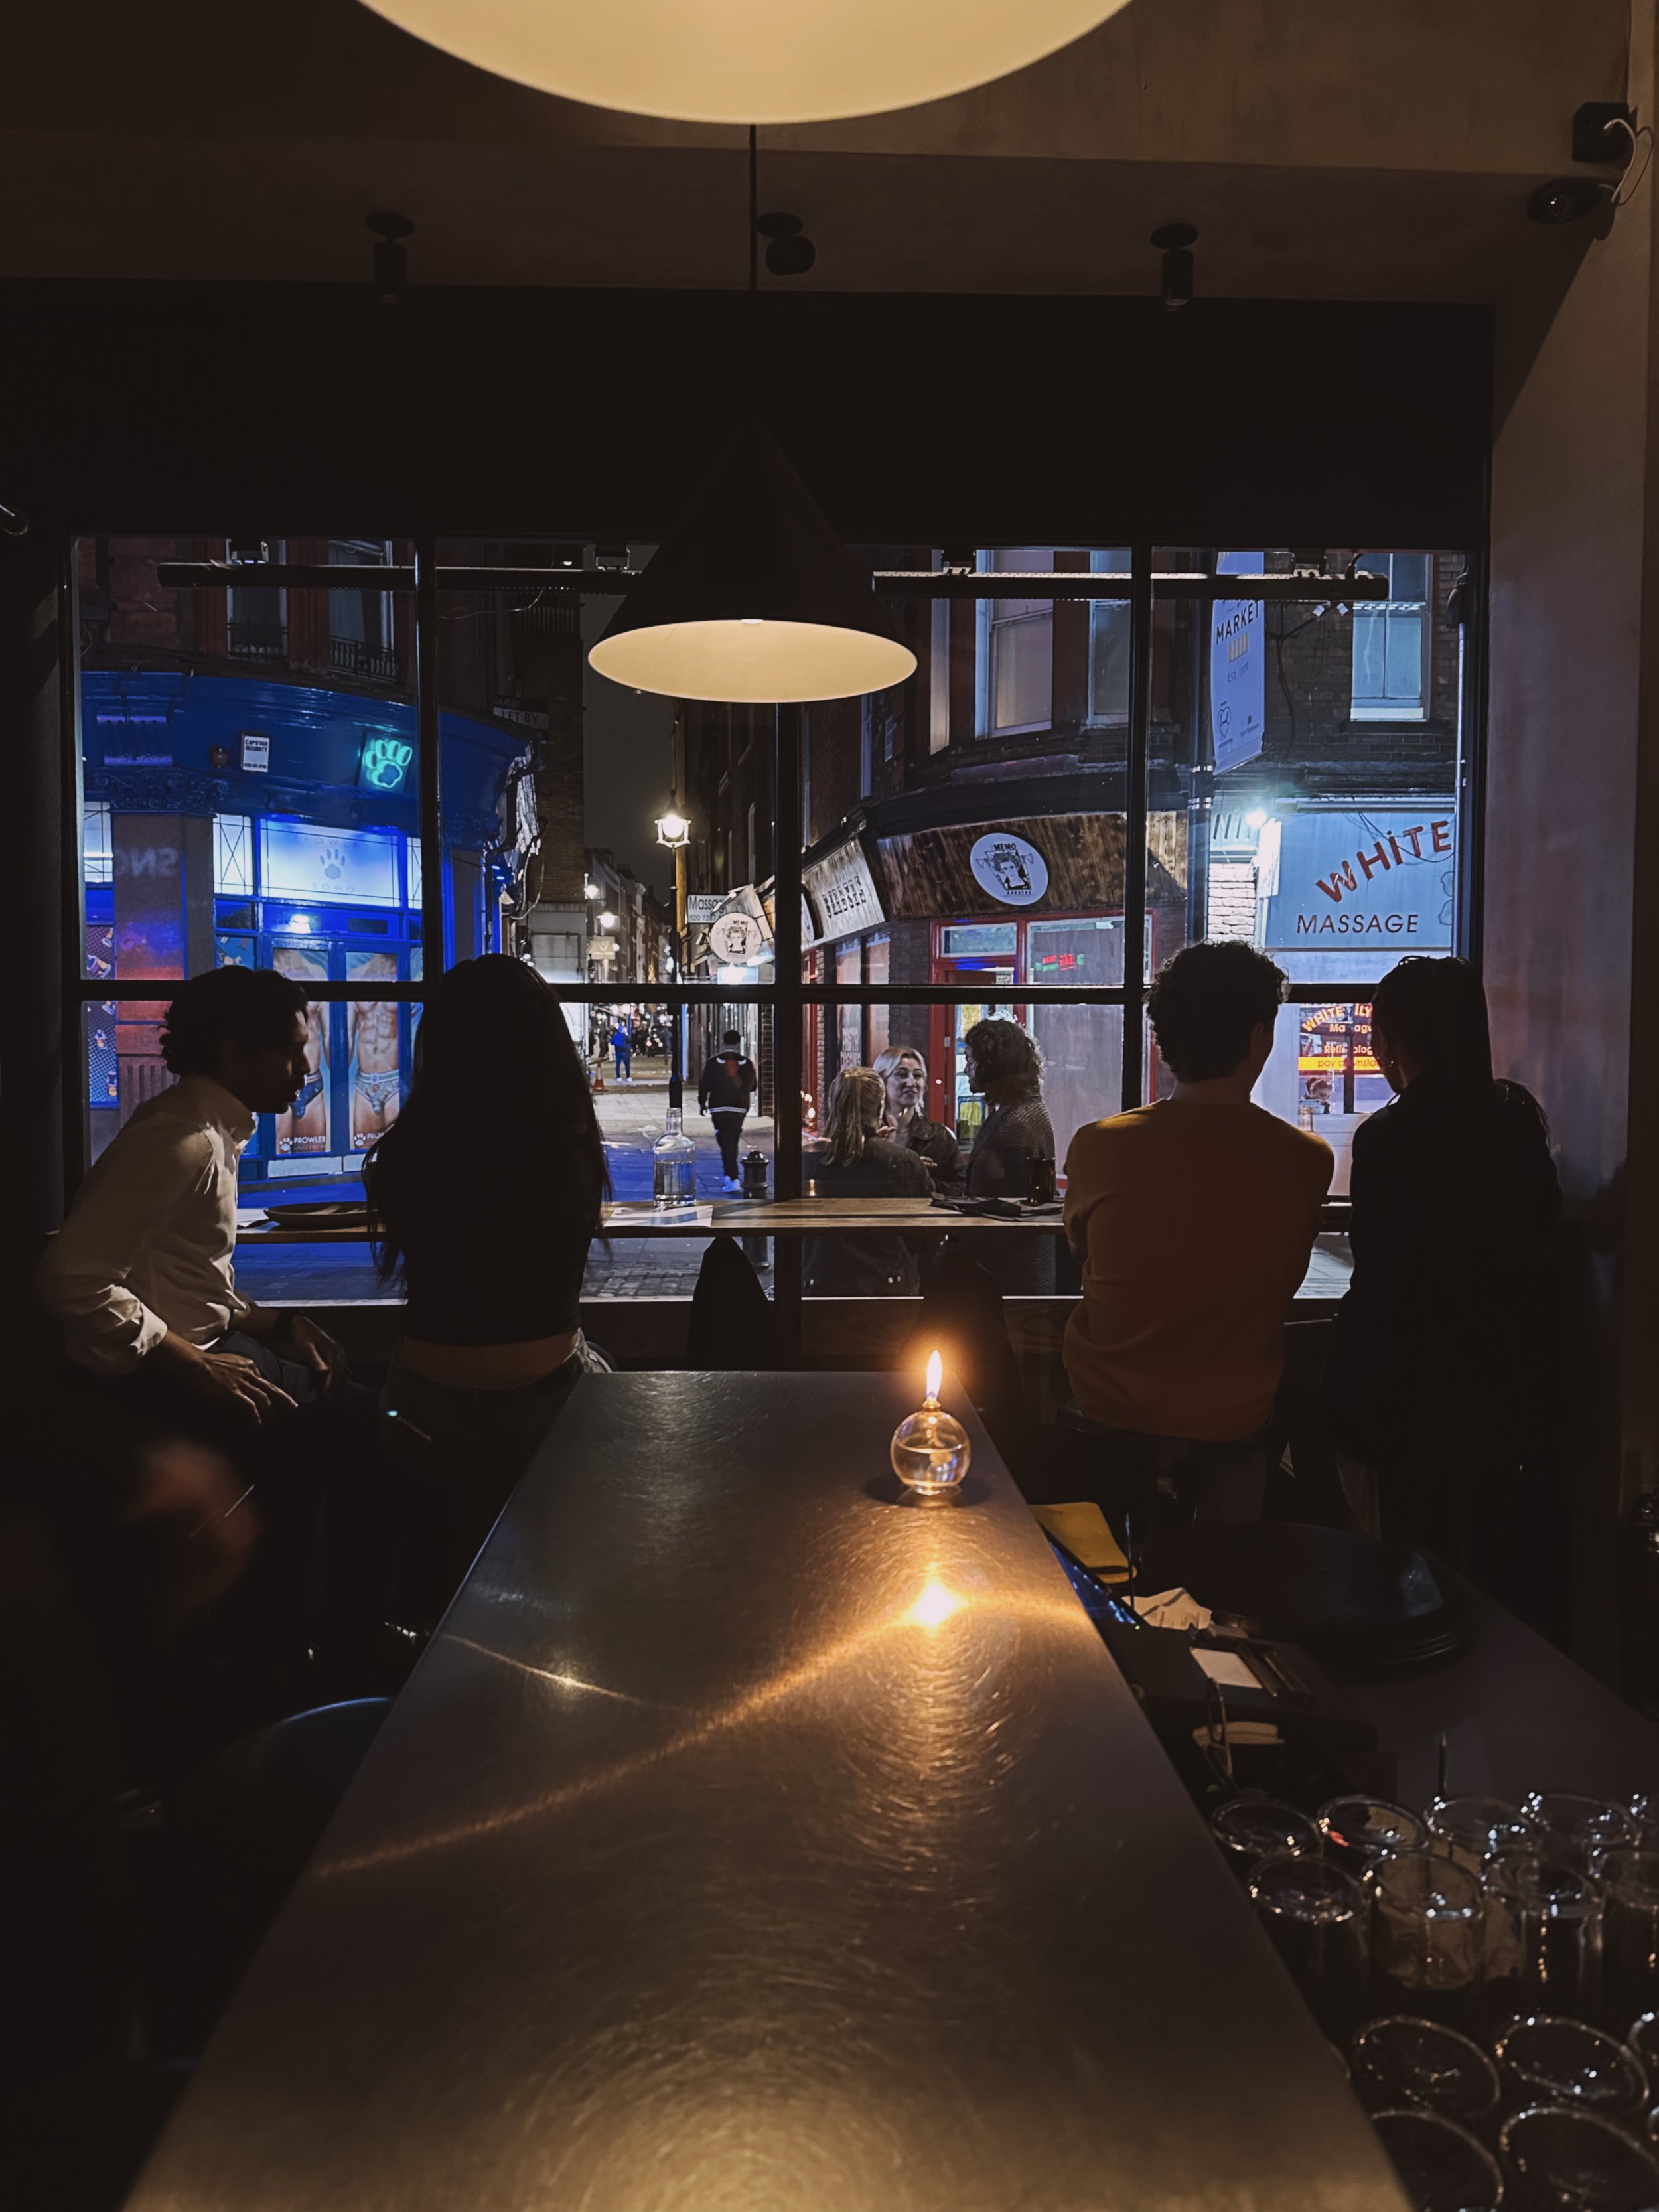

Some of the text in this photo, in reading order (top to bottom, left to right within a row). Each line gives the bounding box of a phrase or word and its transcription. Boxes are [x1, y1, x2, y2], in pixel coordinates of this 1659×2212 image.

[1216, 601, 1258, 644] MARKET
[524, 713, 540, 724] BY
[311, 881, 355, 893] SOHO
[1297, 915, 1419, 934] MASSAGE
[1301, 1005, 1345, 1032] WHITE
[293, 1135, 326, 1143] PROWLER
